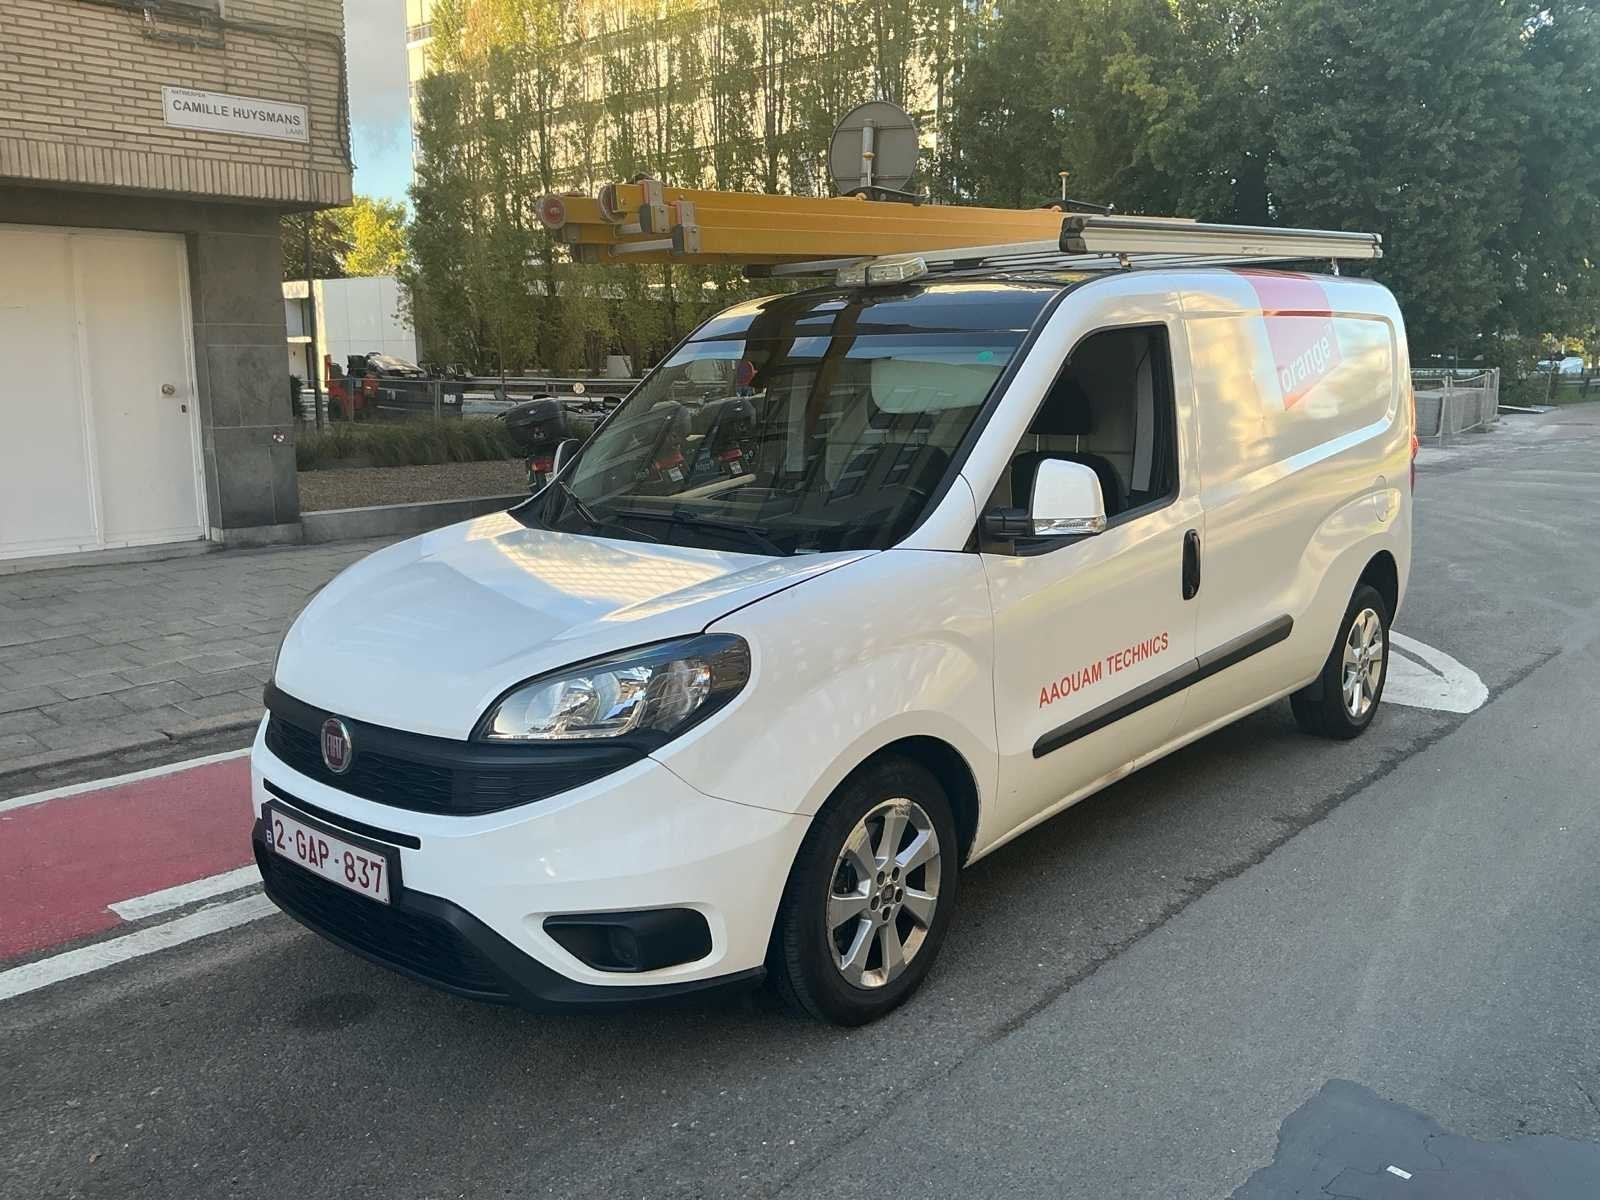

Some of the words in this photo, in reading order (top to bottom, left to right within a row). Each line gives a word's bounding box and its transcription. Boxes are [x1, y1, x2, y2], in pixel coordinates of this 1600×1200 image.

[173, 99, 229, 117] CAMILLE
[233, 107, 301, 126] HUYSMANS
[1281, 337, 1331, 392] orange
[1039, 661, 1103, 709] AAOUAM
[1106, 632, 1169, 675] TECHNICS
[275, 819, 382, 893] 2-GAP-837
